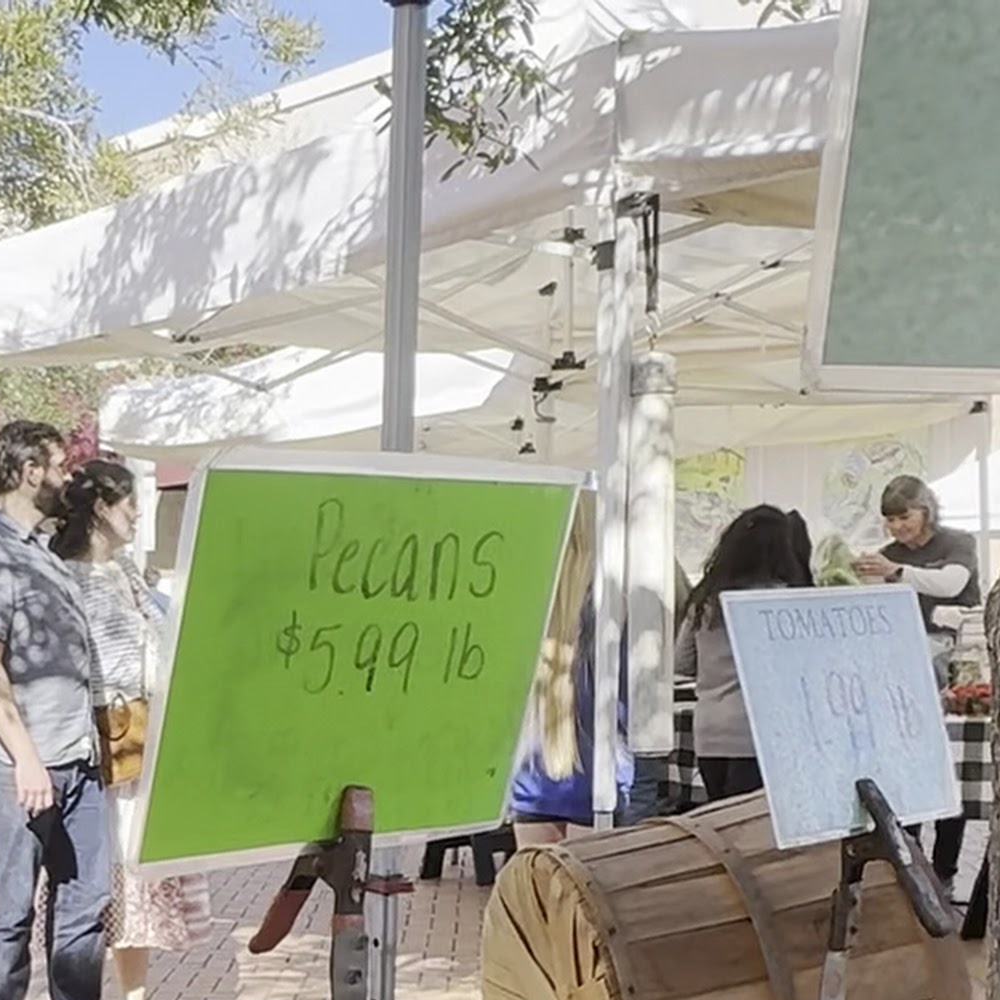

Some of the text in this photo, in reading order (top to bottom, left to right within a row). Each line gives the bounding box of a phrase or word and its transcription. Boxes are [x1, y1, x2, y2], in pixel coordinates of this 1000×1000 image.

[309, 497, 504, 602] Pecans
[276, 610, 485, 694] $5.99 lb
[758, 604, 894, 642] TOMATOES
[800, 671, 877, 752] 1.99
